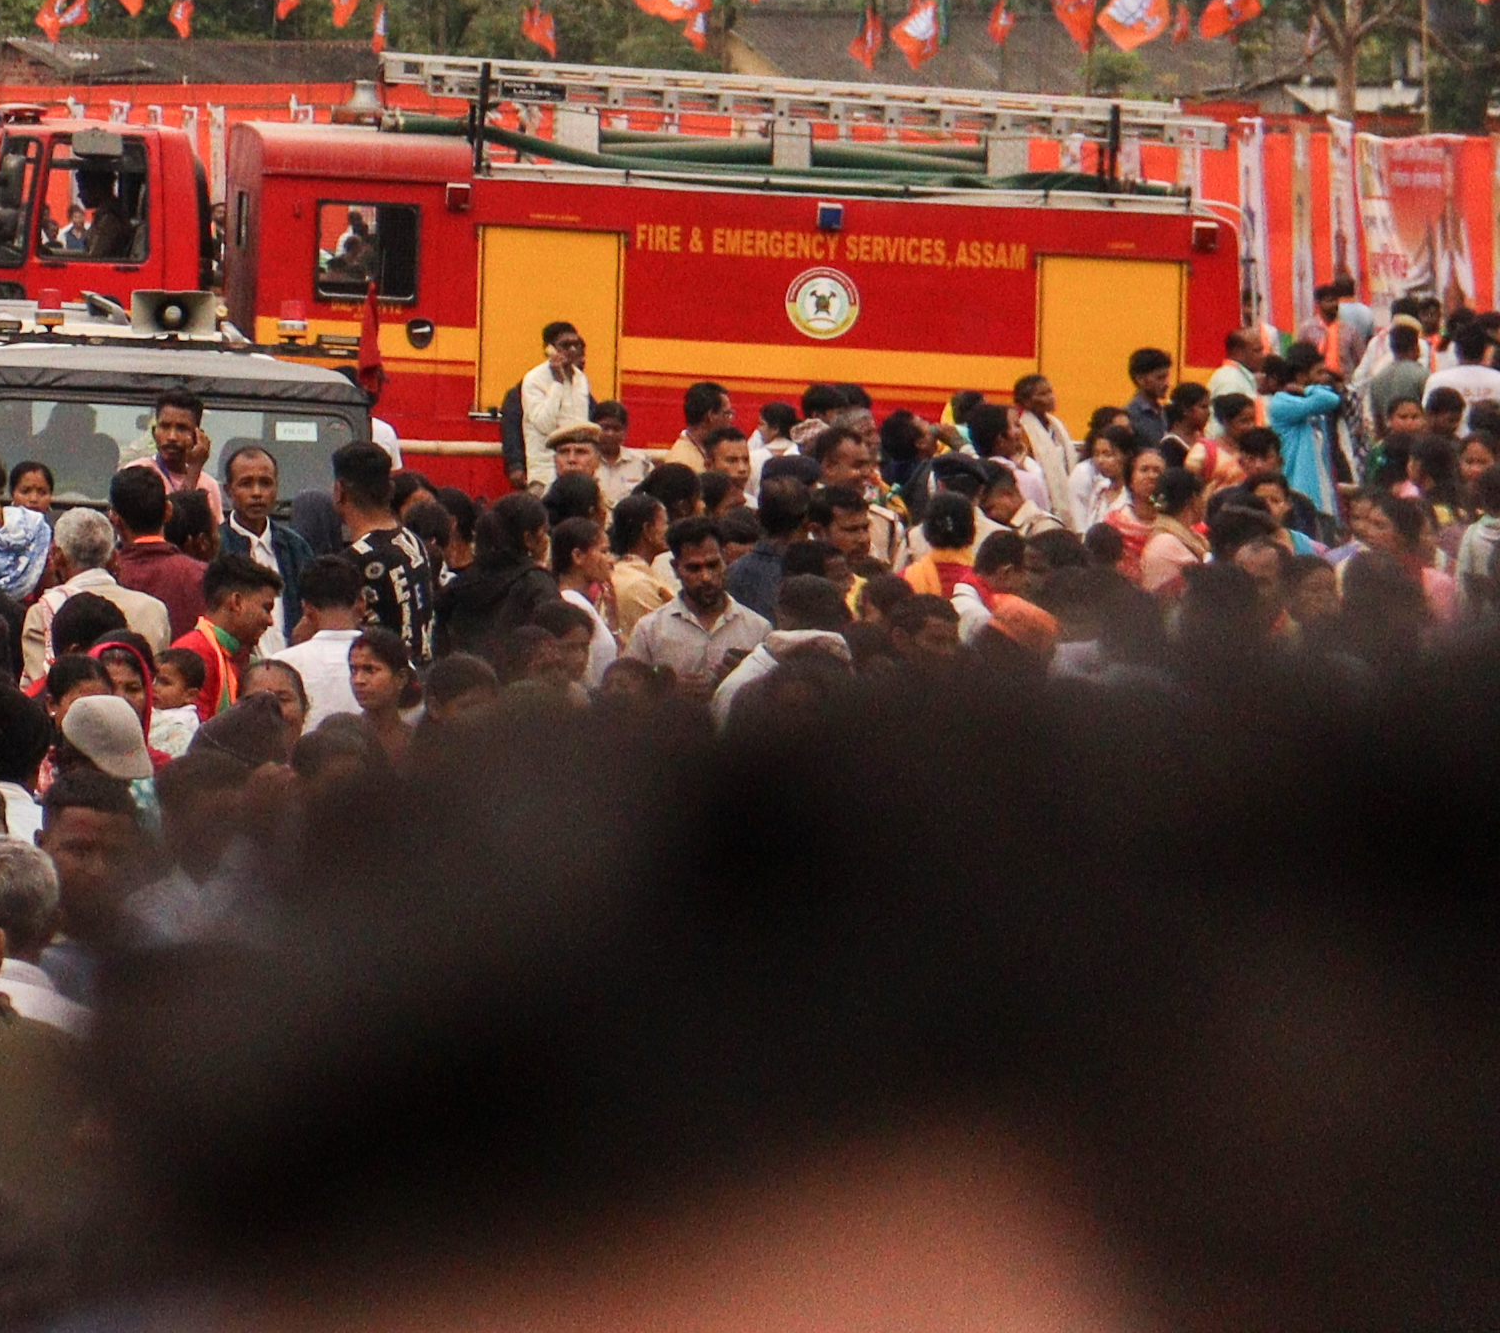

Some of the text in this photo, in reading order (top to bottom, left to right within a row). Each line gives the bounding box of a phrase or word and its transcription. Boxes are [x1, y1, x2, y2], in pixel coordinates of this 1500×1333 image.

[636, 223, 682, 253] FIRE
[688, 227, 705, 254] &
[712, 228, 840, 261] EMERGENCY
[955, 240, 1028, 271] ASSAM
